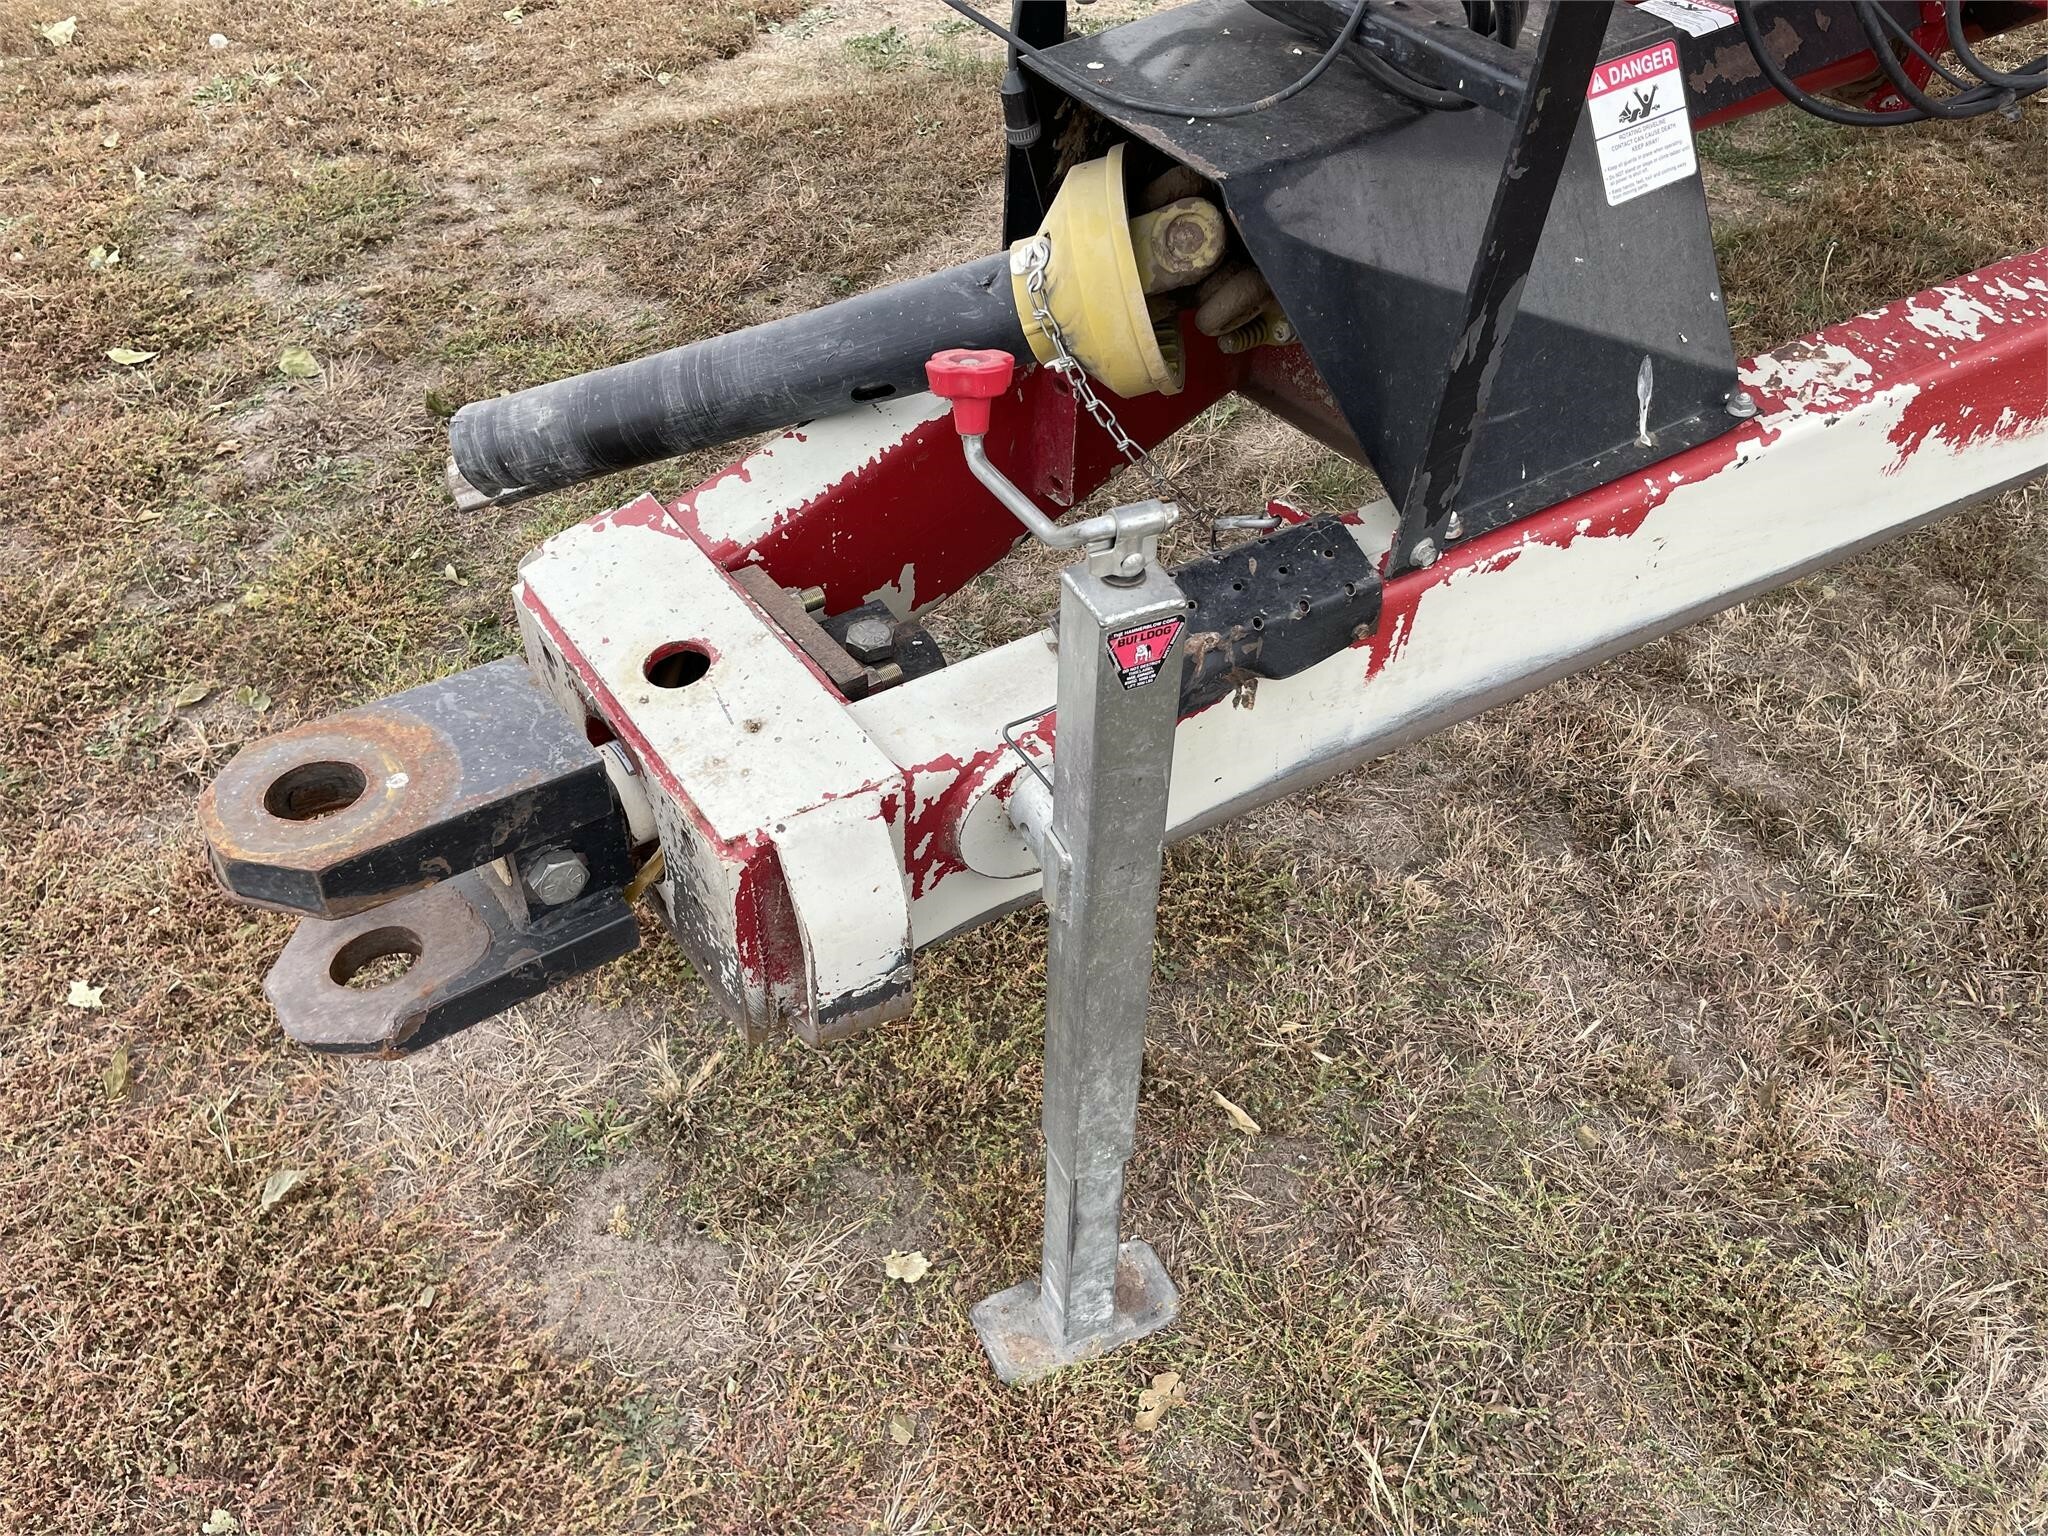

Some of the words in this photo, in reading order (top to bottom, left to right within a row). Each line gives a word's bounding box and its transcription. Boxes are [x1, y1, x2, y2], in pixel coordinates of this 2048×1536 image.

[1608, 48, 1673, 85] DANGER
[1611, 139, 1633, 151] CONTACT
[1645, 129, 1660, 138] CAUSE
[1661, 123, 1676, 132] DEATH
[1619, 127, 1641, 139] ROTATING
[1642, 118, 1666, 131] DRIVELINE
[1645, 137, 1659, 146] AWAY!
[1118, 626, 1171, 647] BULLDOG
